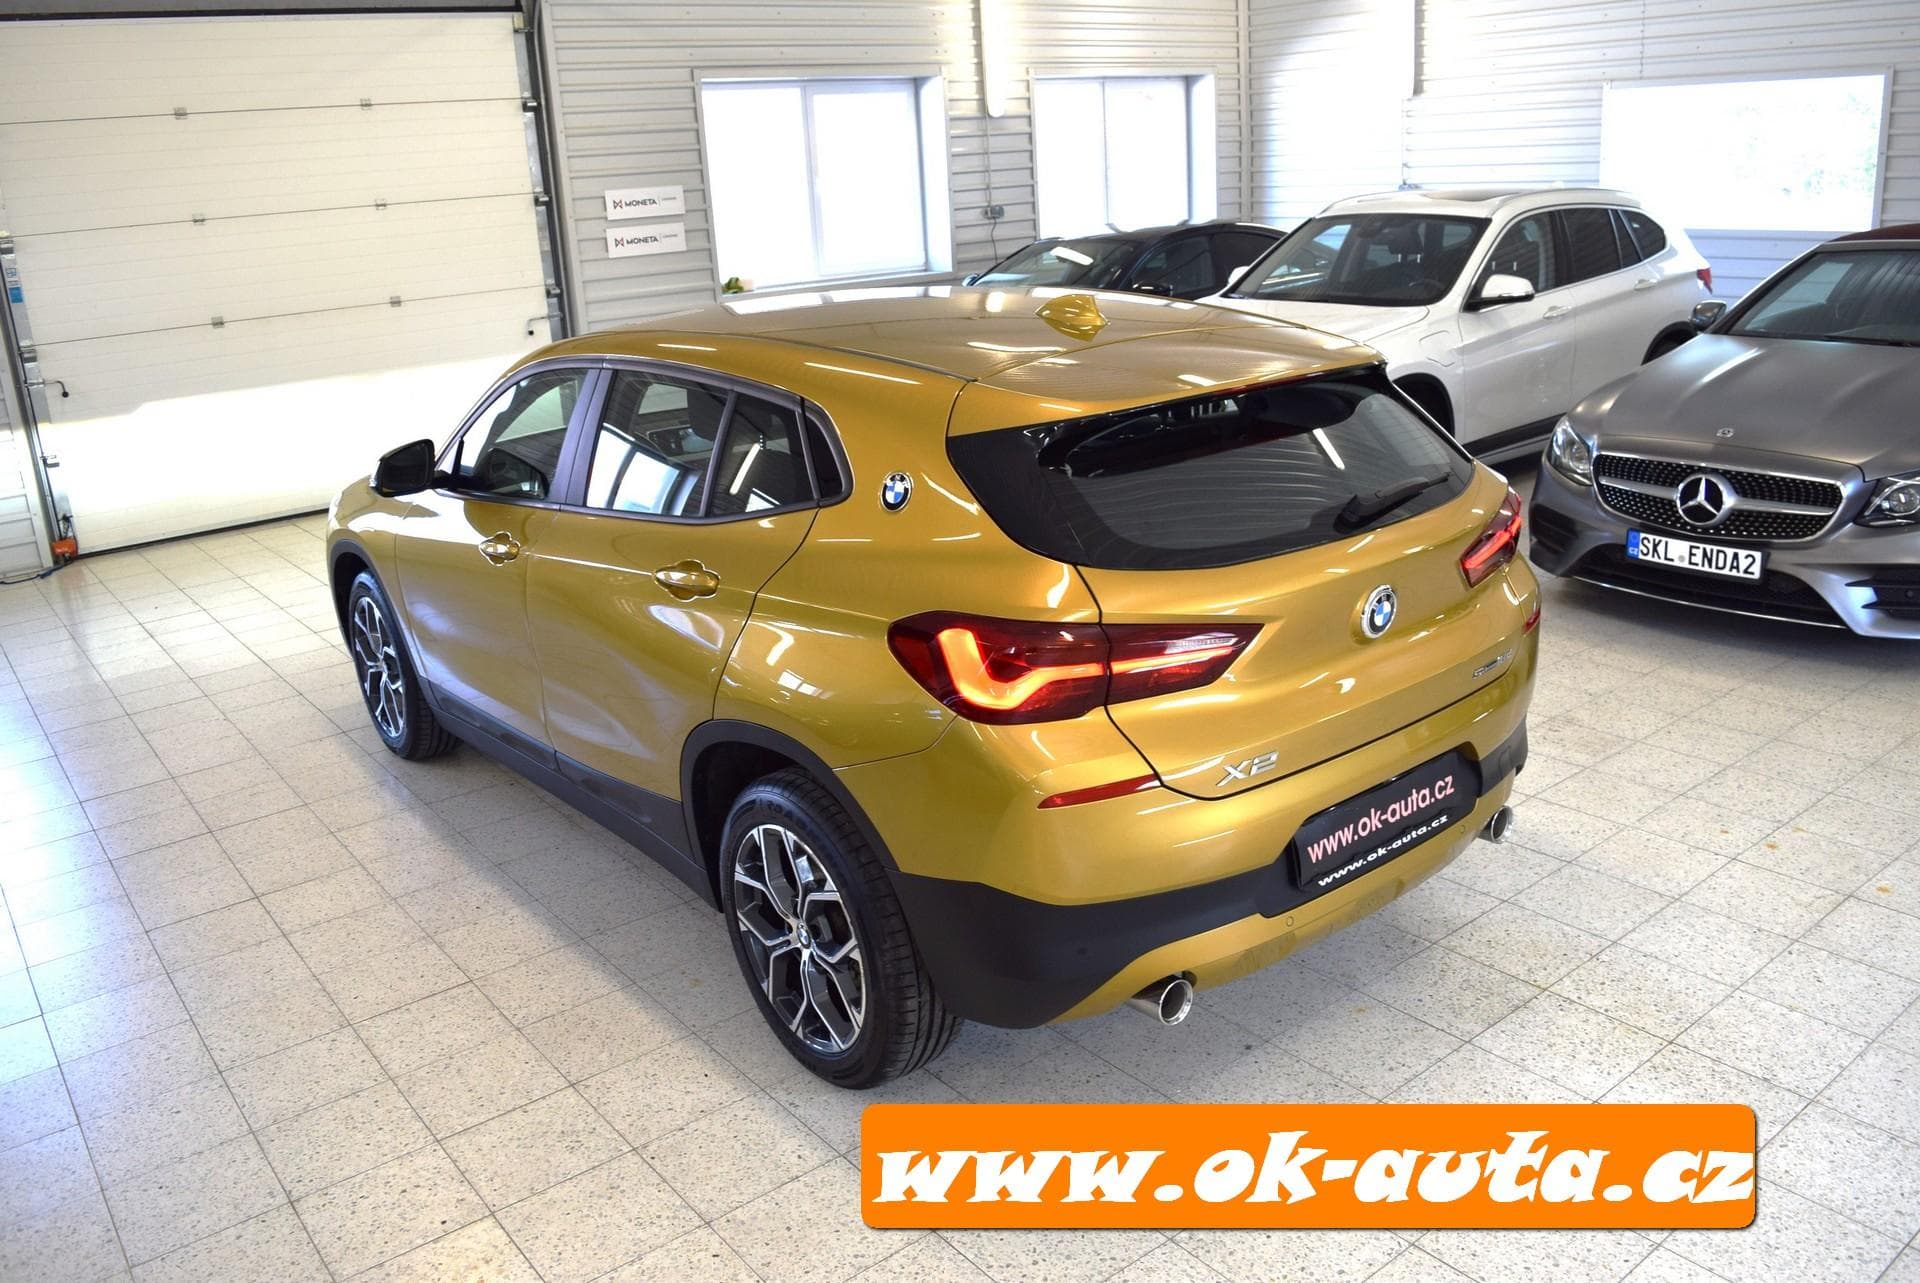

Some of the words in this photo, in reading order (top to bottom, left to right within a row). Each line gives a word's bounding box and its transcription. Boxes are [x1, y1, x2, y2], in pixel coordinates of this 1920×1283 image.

[624, 198, 658, 207] MONETA
[625, 235, 659, 245] MONETA
[1640, 536, 1675, 562] SKL
[1688, 545, 1756, 576] ENDA2
[1216, 752, 1279, 787] X2
[1307, 775, 1455, 864] www.ok-auta.cz
[1318, 814, 1449, 887] www.ok-auta.cz
